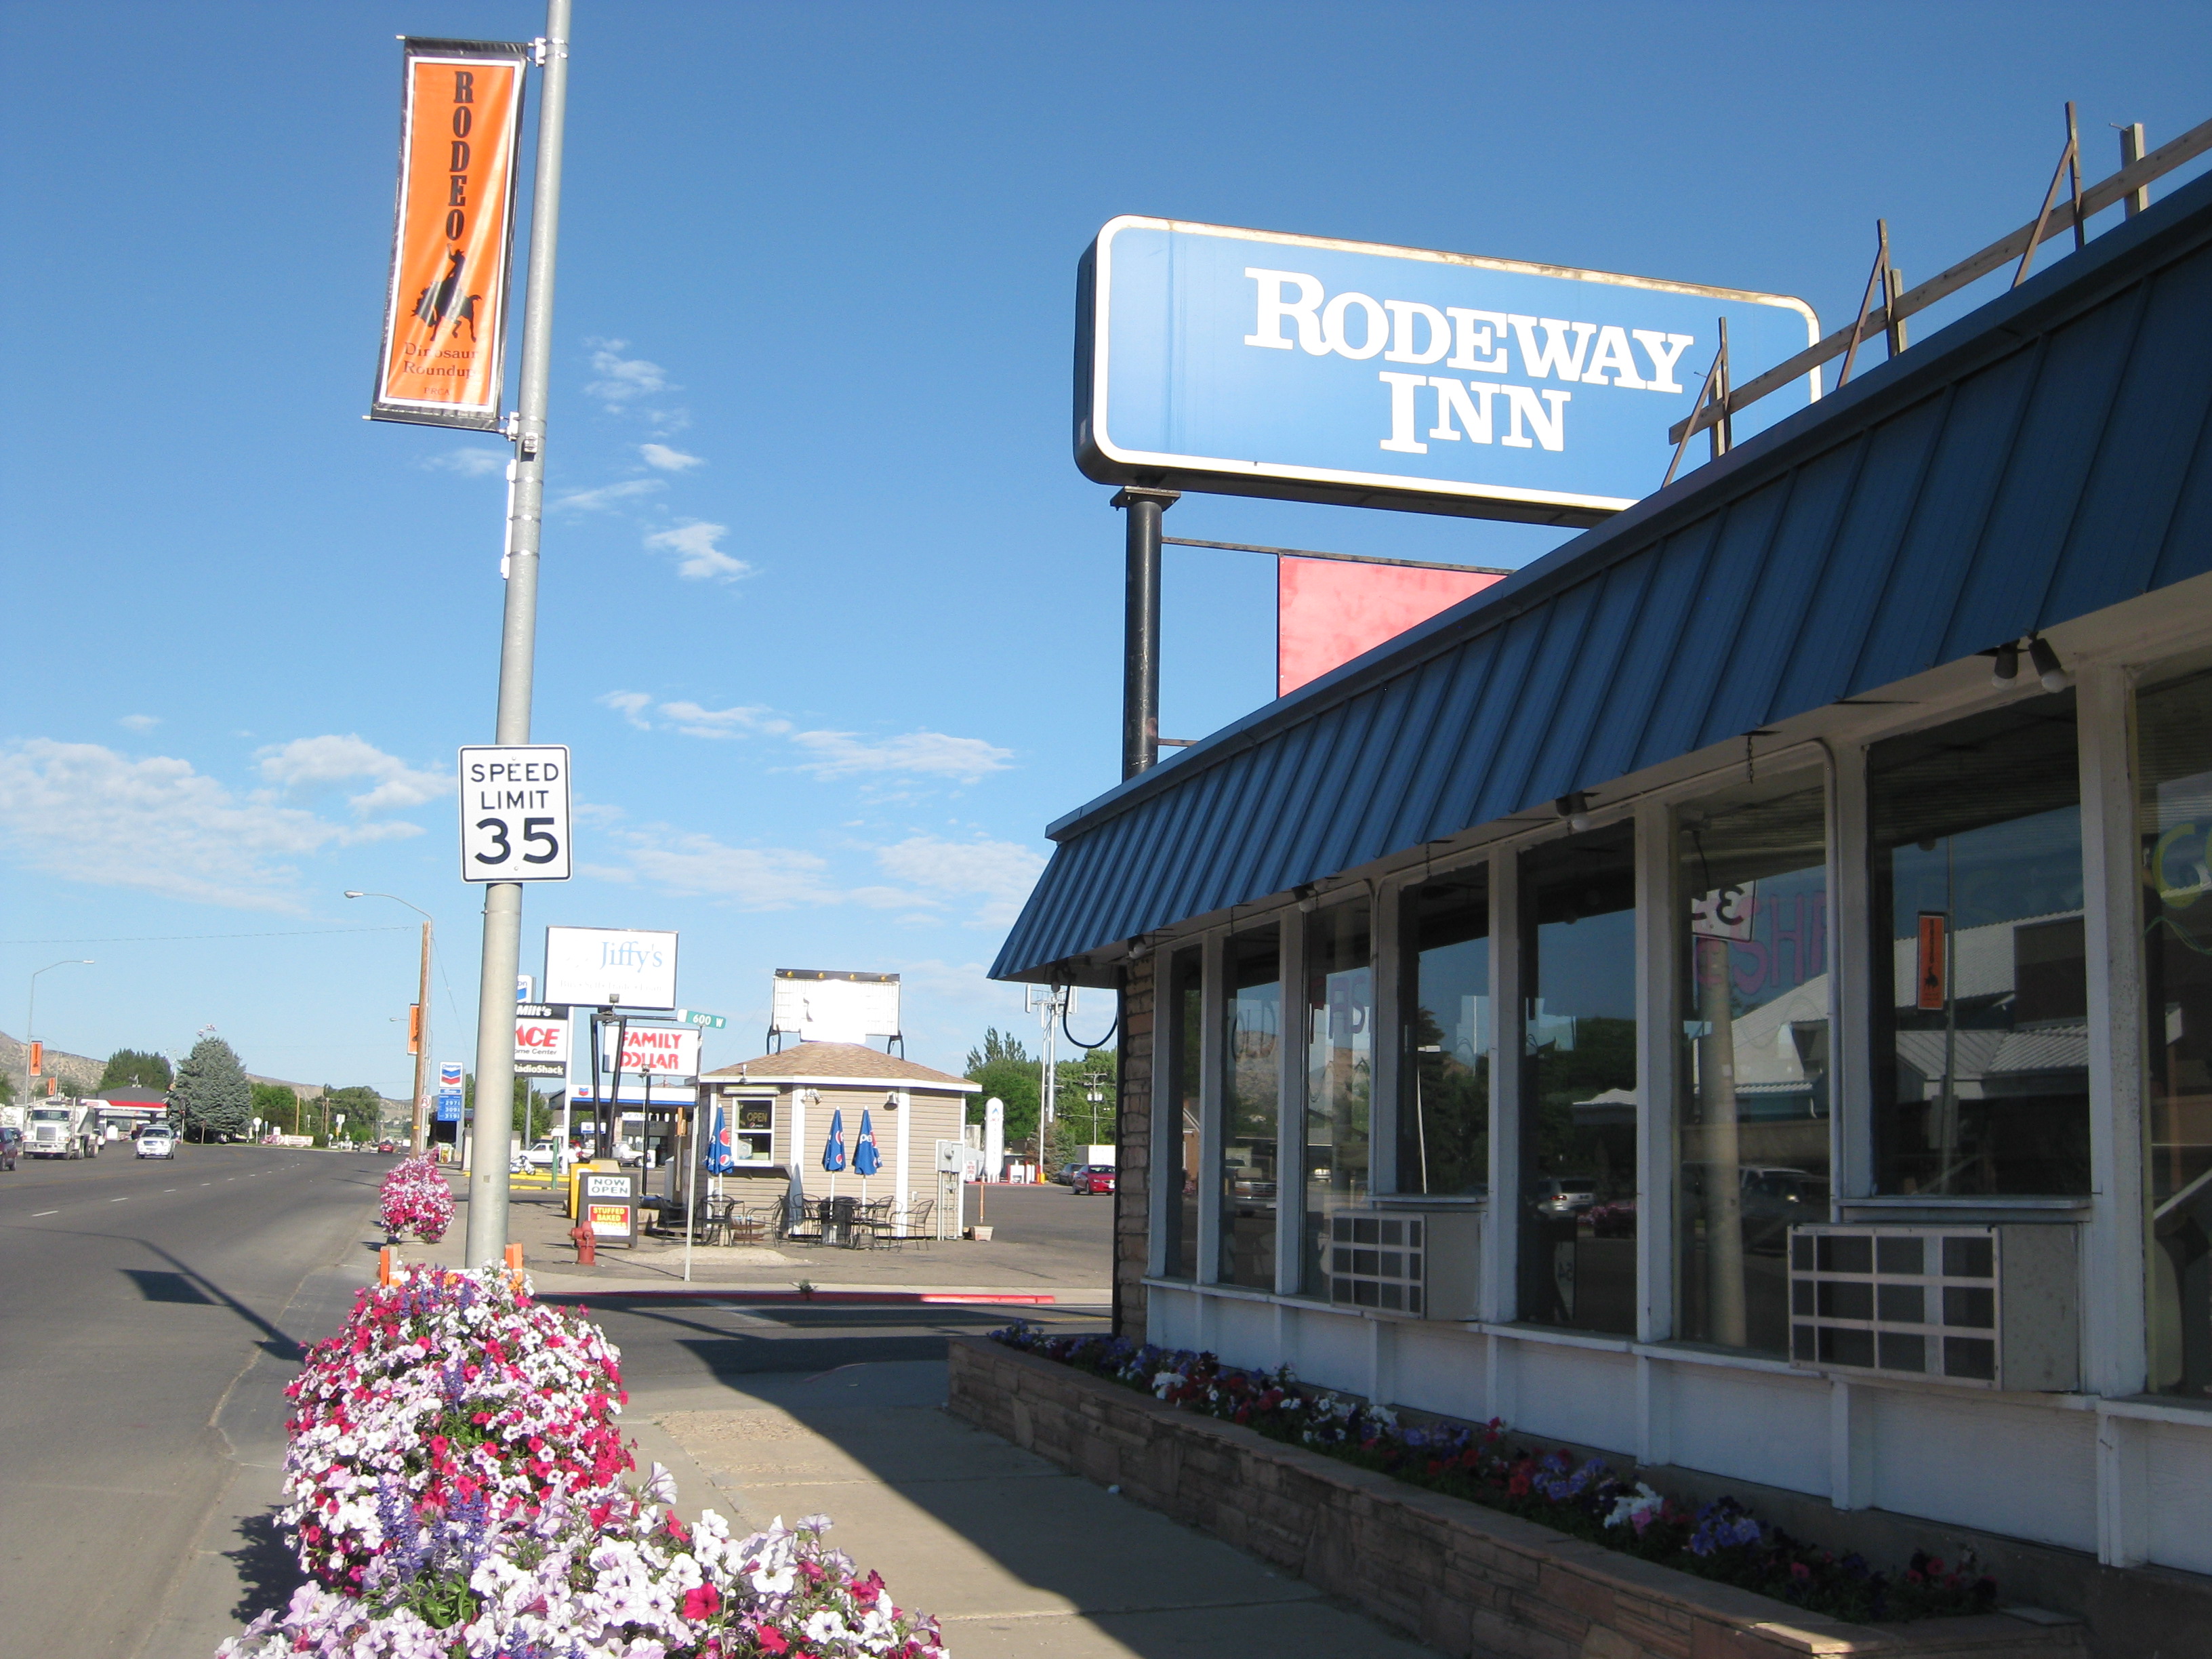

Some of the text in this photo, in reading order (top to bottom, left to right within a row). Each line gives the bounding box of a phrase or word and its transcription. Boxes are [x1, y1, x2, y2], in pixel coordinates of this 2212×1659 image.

[445, 70, 474, 241] RODEO
[1244, 266, 1694, 394] RODEWAY
[405, 342, 478, 359] Dinosaur
[403, 360, 476, 379] Roundup
[424, 387, 450, 396] PRCA
[1378, 370, 1572, 454] INN
[470, 763, 559, 782] SPEED
[481, 790, 549, 809] LIMIT
[474, 817, 559, 865] 35
[599, 940, 663, 973] Jiffy's
[516, 1005, 552, 1017] Milt's
[692, 1014, 724, 1027] 600 W
[515, 1024, 560, 1048] ACE
[623, 1031, 682, 1049] FAMILY
[621, 1051, 679, 1069] DOLLAR
[514, 1063, 564, 1076] RadioShack
[747, 1112, 768, 1122] OPEN
[596, 1214, 621, 1222] BAKED
